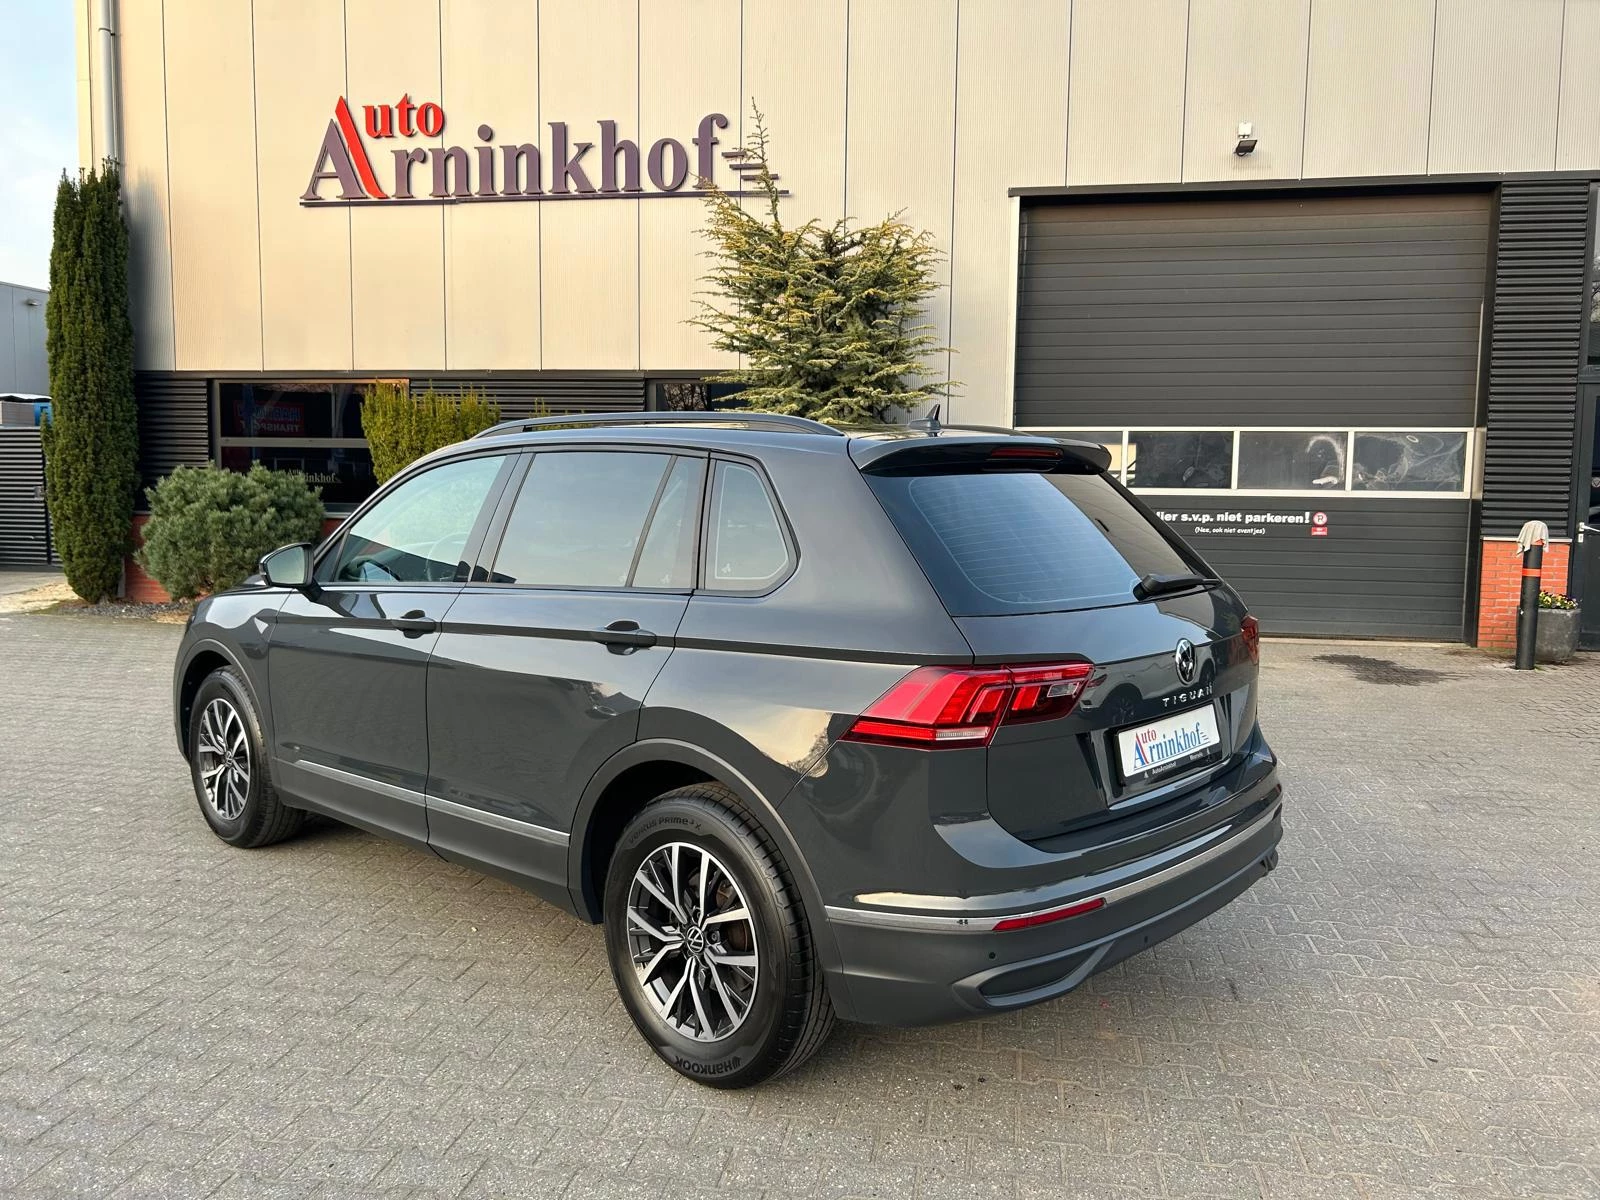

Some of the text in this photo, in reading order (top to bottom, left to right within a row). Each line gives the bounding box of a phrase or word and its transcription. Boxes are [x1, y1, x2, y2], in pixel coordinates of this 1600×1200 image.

[300, 96, 728, 200] Arninkhof
[1155, 511, 1310, 524] ier s.v.p. niet parkeren!
[1162, 685, 1213, 708] TIGUAN
[1133, 722, 1201, 769] Arninkhof
